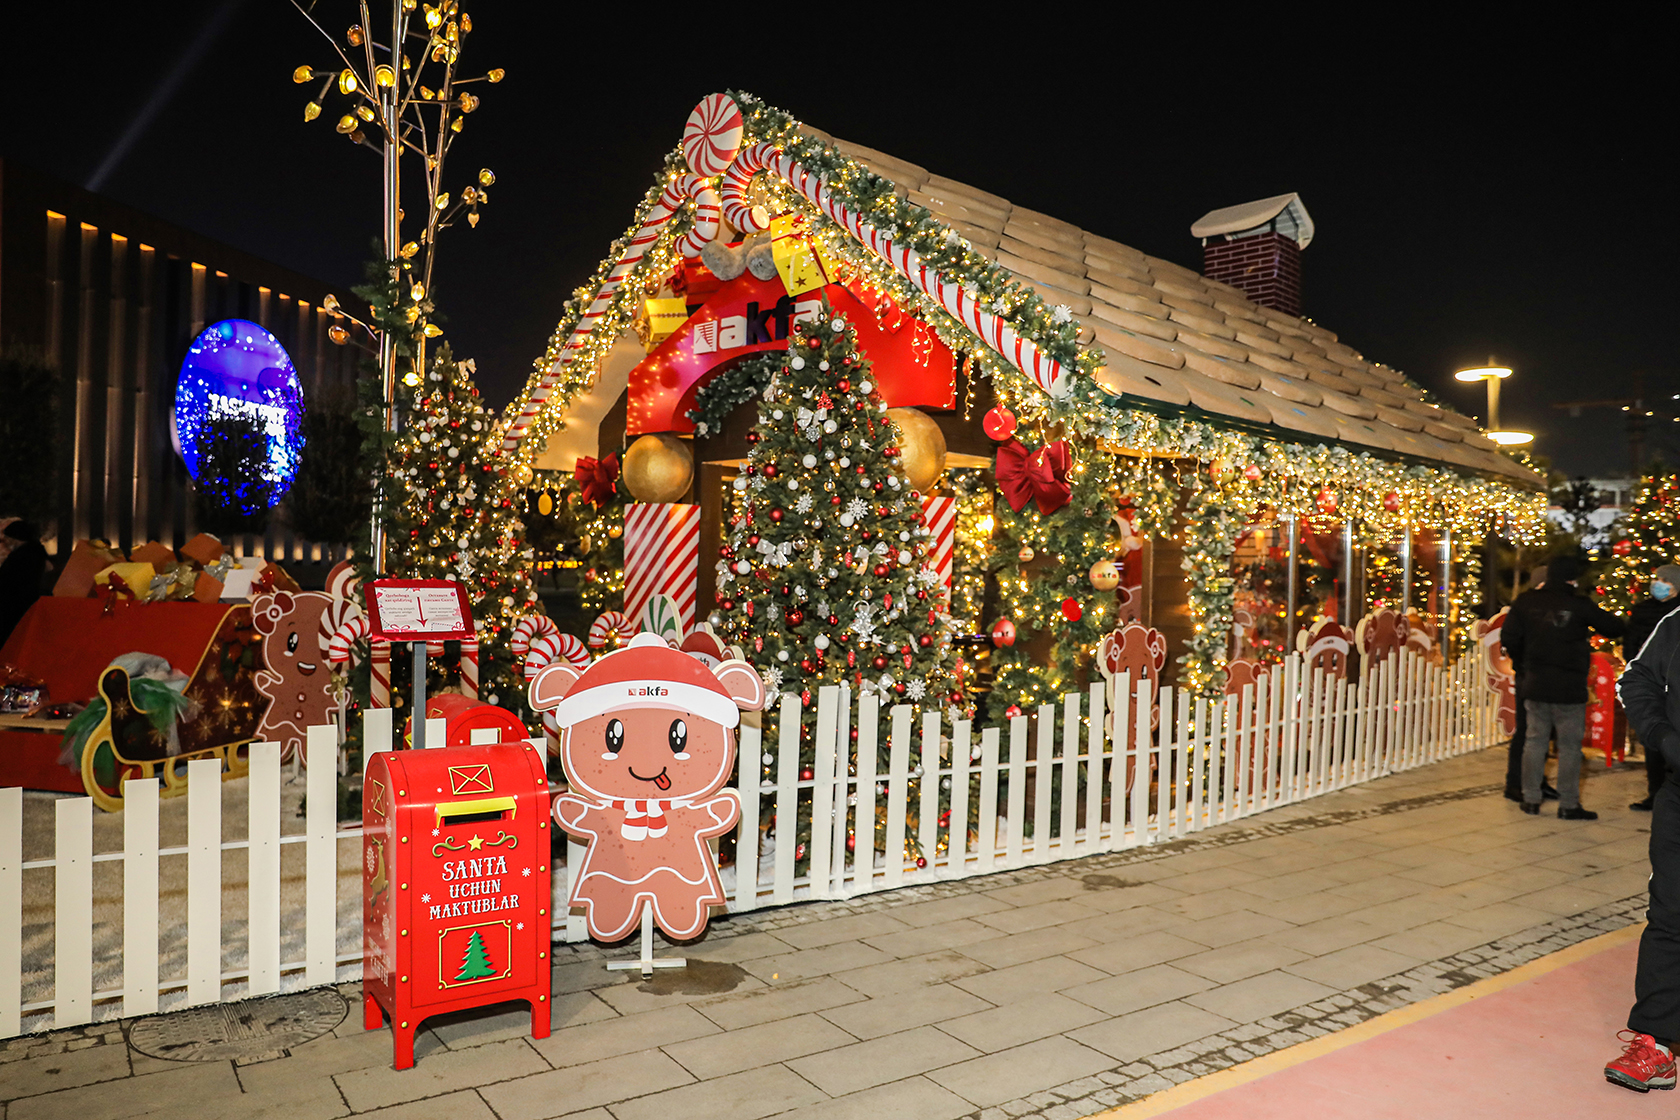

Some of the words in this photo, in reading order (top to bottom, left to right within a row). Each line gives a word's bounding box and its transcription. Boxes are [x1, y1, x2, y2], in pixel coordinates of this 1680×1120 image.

[638, 686, 668, 696] akfa
[442, 855, 508, 882] SANTA
[449, 878, 502, 899] UCHUN
[429, 894, 520, 920] MAKTUBLAR
